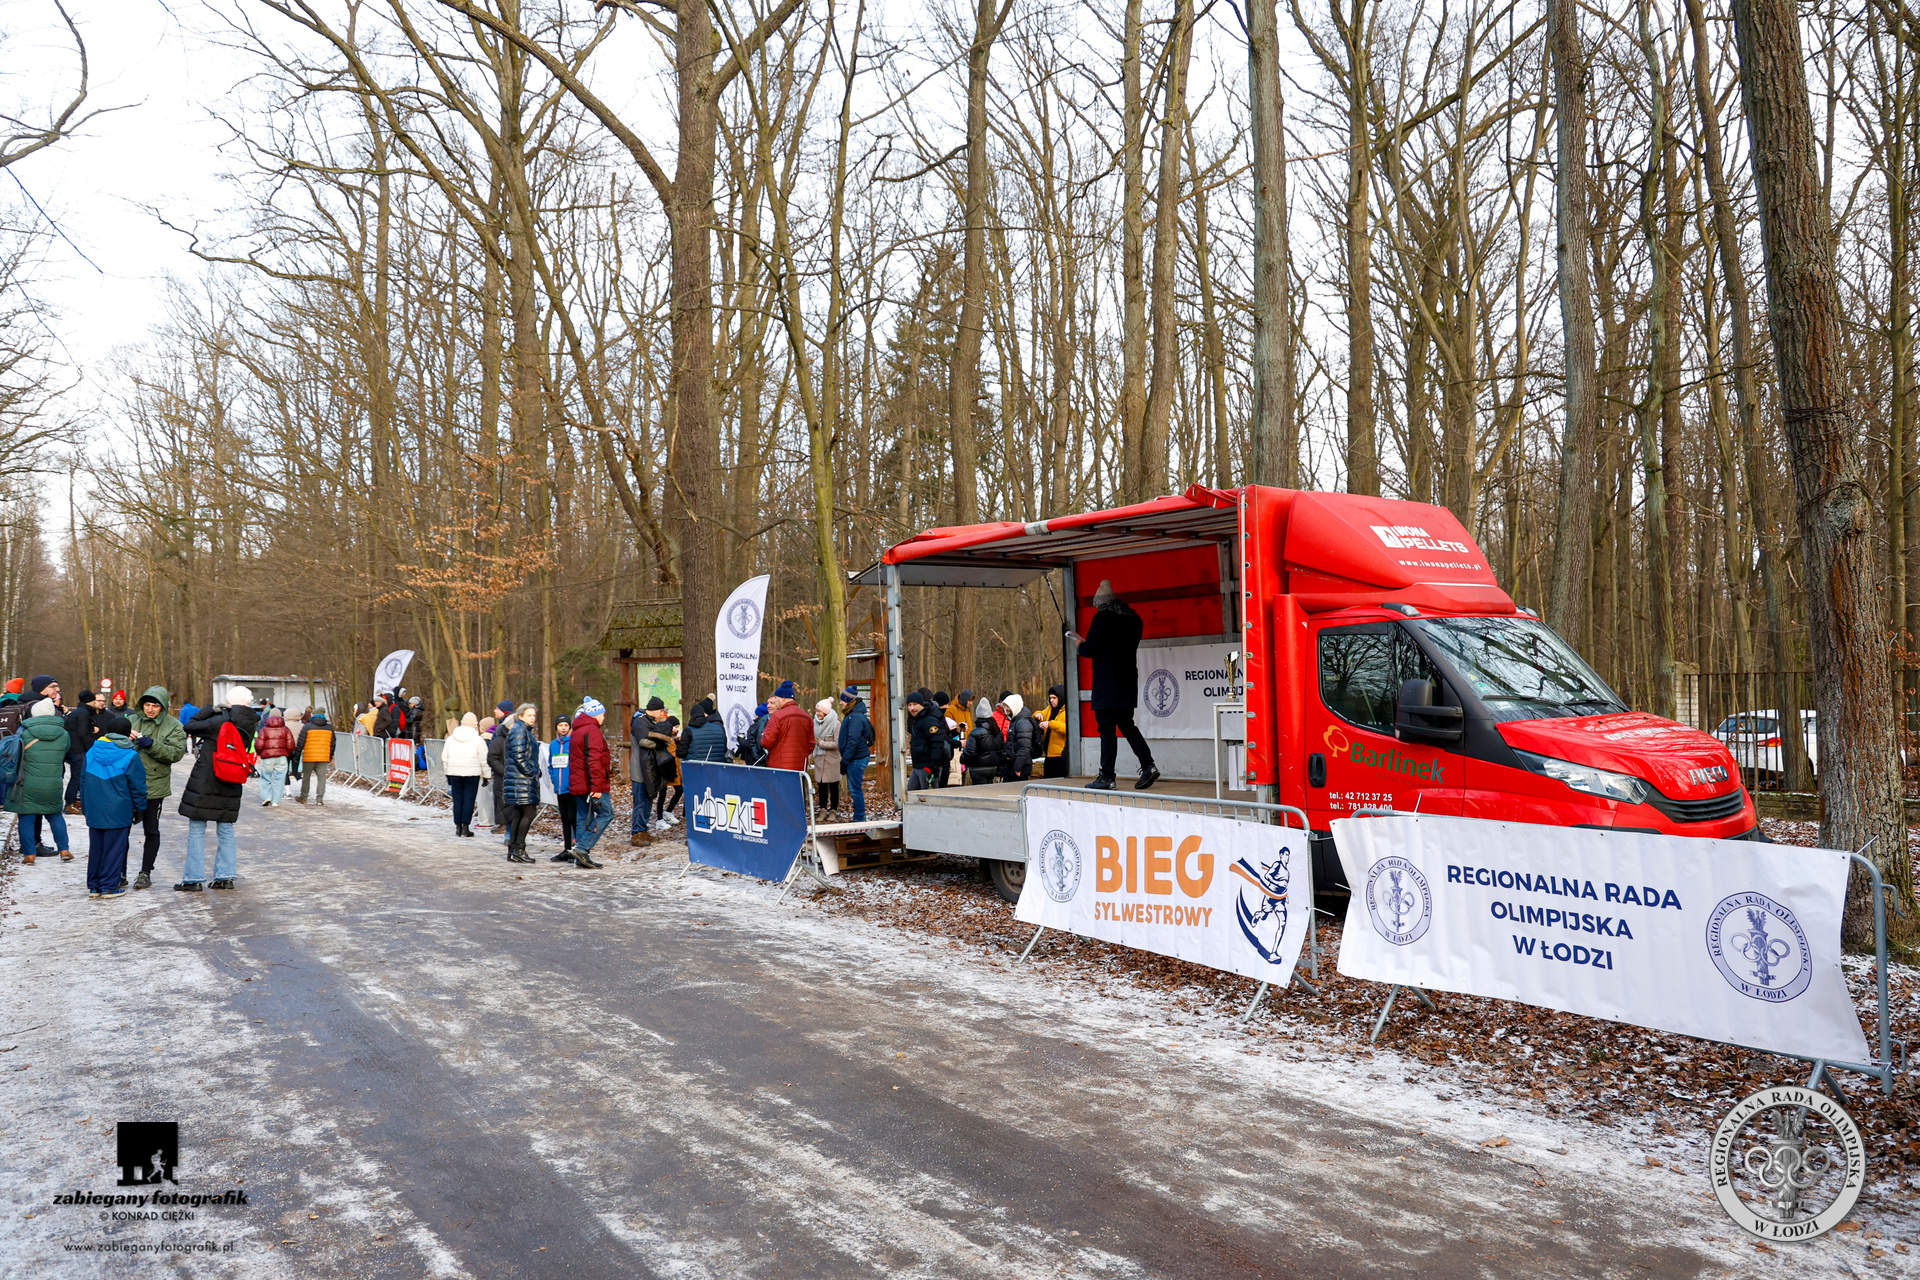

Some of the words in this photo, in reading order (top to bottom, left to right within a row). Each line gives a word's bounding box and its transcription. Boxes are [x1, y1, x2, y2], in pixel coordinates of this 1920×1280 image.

[1400, 537, 1470, 553] PELLETS
[1398, 559, 1482, 571] www.iwonapellets.pl
[1350, 742, 1445, 784] Barlinek
[1688, 765, 1729, 786] IVECO
[1329, 791, 1344, 800] tel.:
[1345, 792, 1355, 800] 42
[1356, 792, 1370, 801] 712
[1371, 793, 1381, 801] 37
[1382, 793, 1393, 801] 25
[1330, 802, 1344, 810] tel.:
[1347, 802, 1361, 810] 781
[1095, 834, 1215, 898] BIEG
[1447, 863, 1598, 901] REGIONALNA
[1604, 882, 1683, 911] RADA
[1094, 901, 1213, 928] SYLWESTROWY
[1745, 895, 1771, 910] RADA
[1490, 901, 1634, 940] OLIMPIJSKA
[1512, 934, 1536, 957] W
[1540, 939, 1614, 971] ŁODZI
